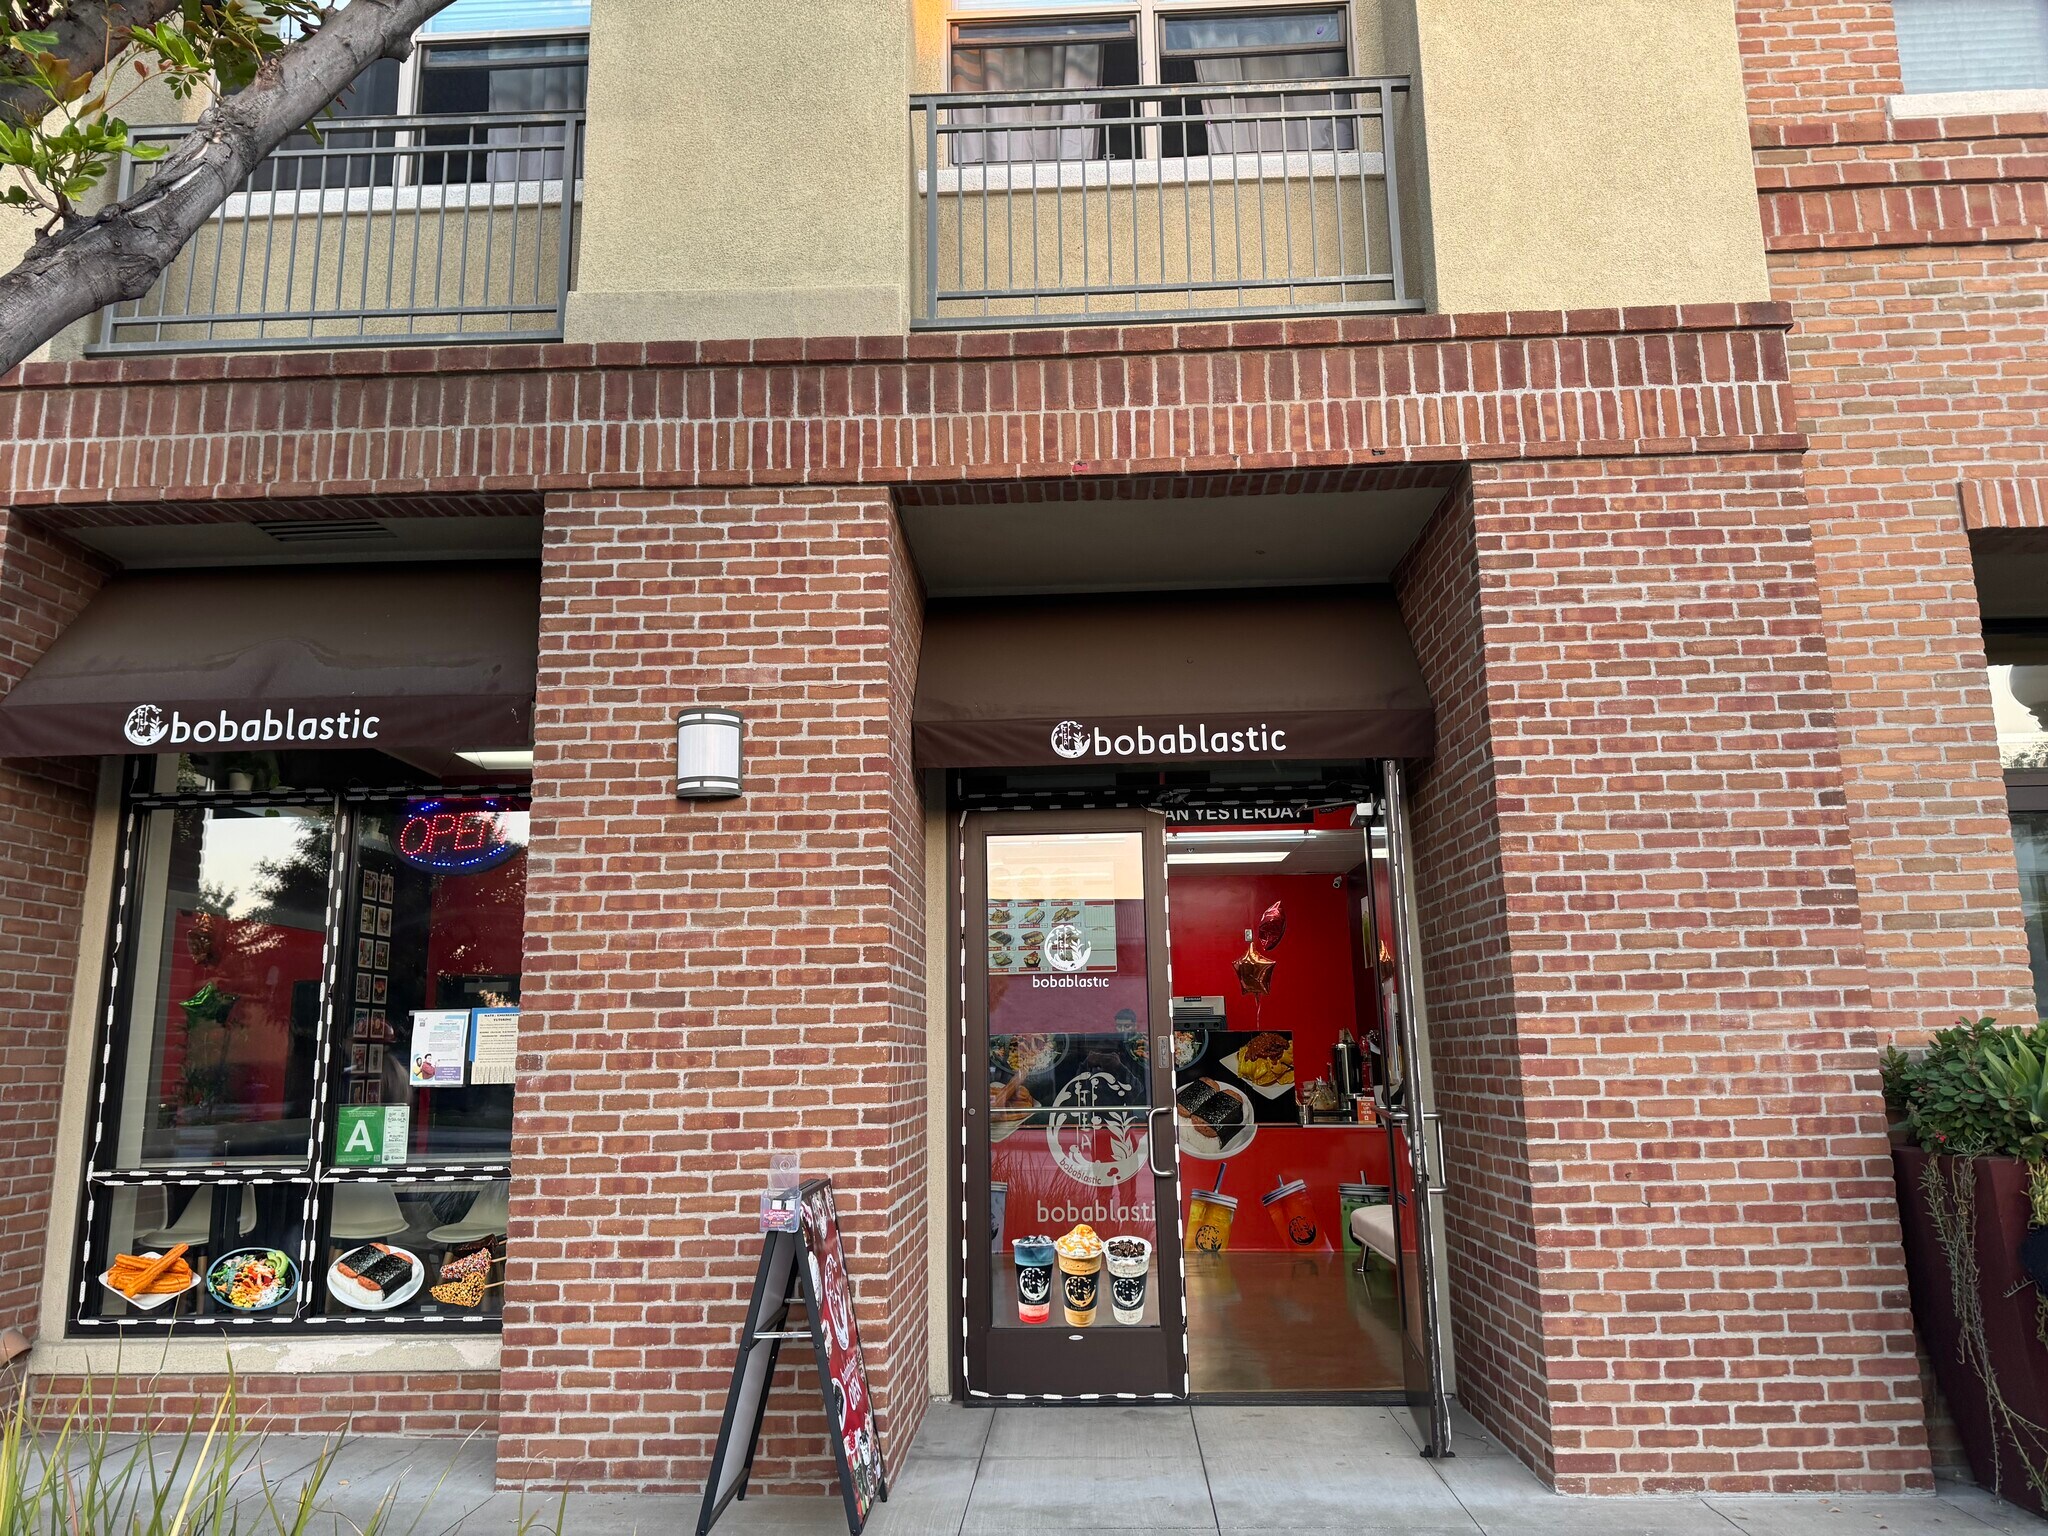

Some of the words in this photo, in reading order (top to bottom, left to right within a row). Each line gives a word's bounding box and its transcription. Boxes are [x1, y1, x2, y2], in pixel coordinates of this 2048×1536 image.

[169, 708, 380, 743] bobablastic
[1093, 723, 1287, 756] bobablastic
[400, 807, 510, 855] OPEN
[1032, 974, 1110, 988] bobablastic
[344, 1119, 374, 1152] A
[1059, 1157, 1102, 1186] bobablastic
